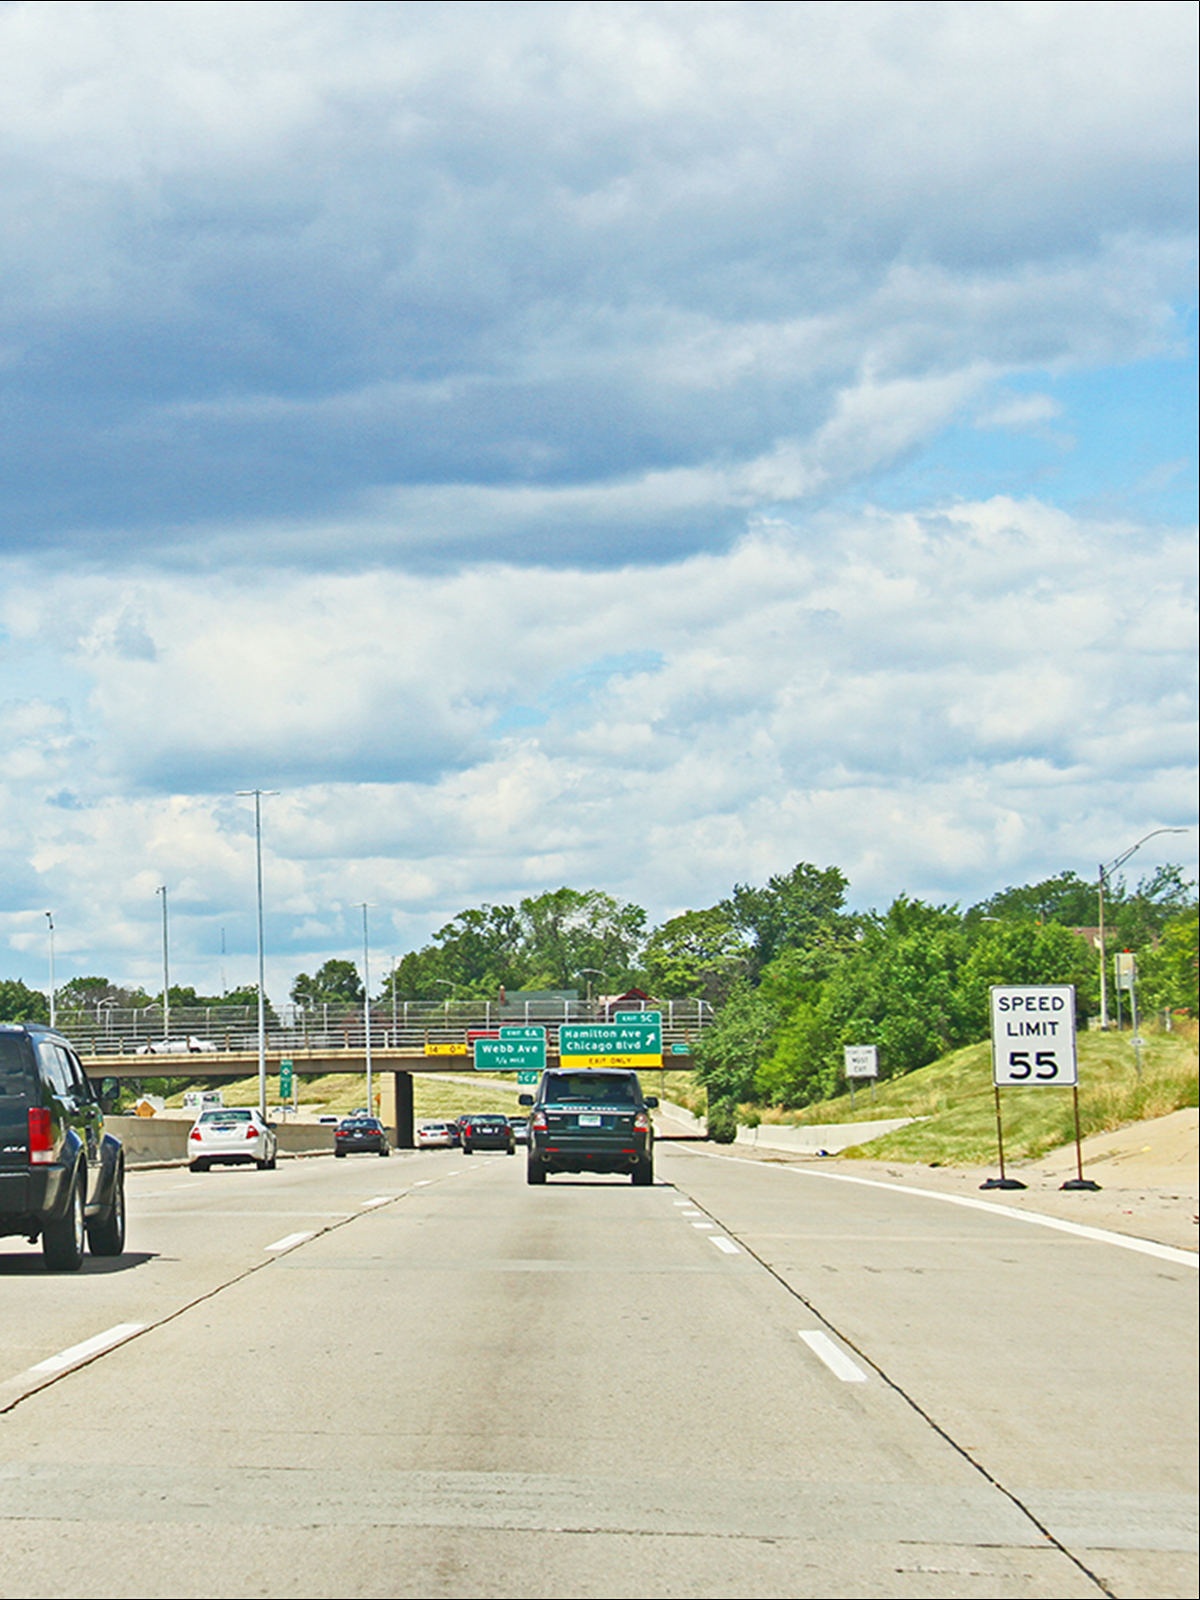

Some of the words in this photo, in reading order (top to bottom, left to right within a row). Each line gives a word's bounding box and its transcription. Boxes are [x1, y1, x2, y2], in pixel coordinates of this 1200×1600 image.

[998, 996, 1065, 1012] SPEED
[641, 1014, 652, 1022] 5C
[524, 1029, 538, 1037] 6A
[565, 1029, 617, 1038] Hamilton
[620, 1030, 641, 1038] Ave
[1006, 1021, 1059, 1037] LIMIT
[481, 1044, 514, 1053] Webb
[517, 1044, 538, 1053] Ave
[566, 1041, 613, 1052] Chicago
[616, 1041, 641, 1050] Blvd
[1008, 1051, 1059, 1080] 55
